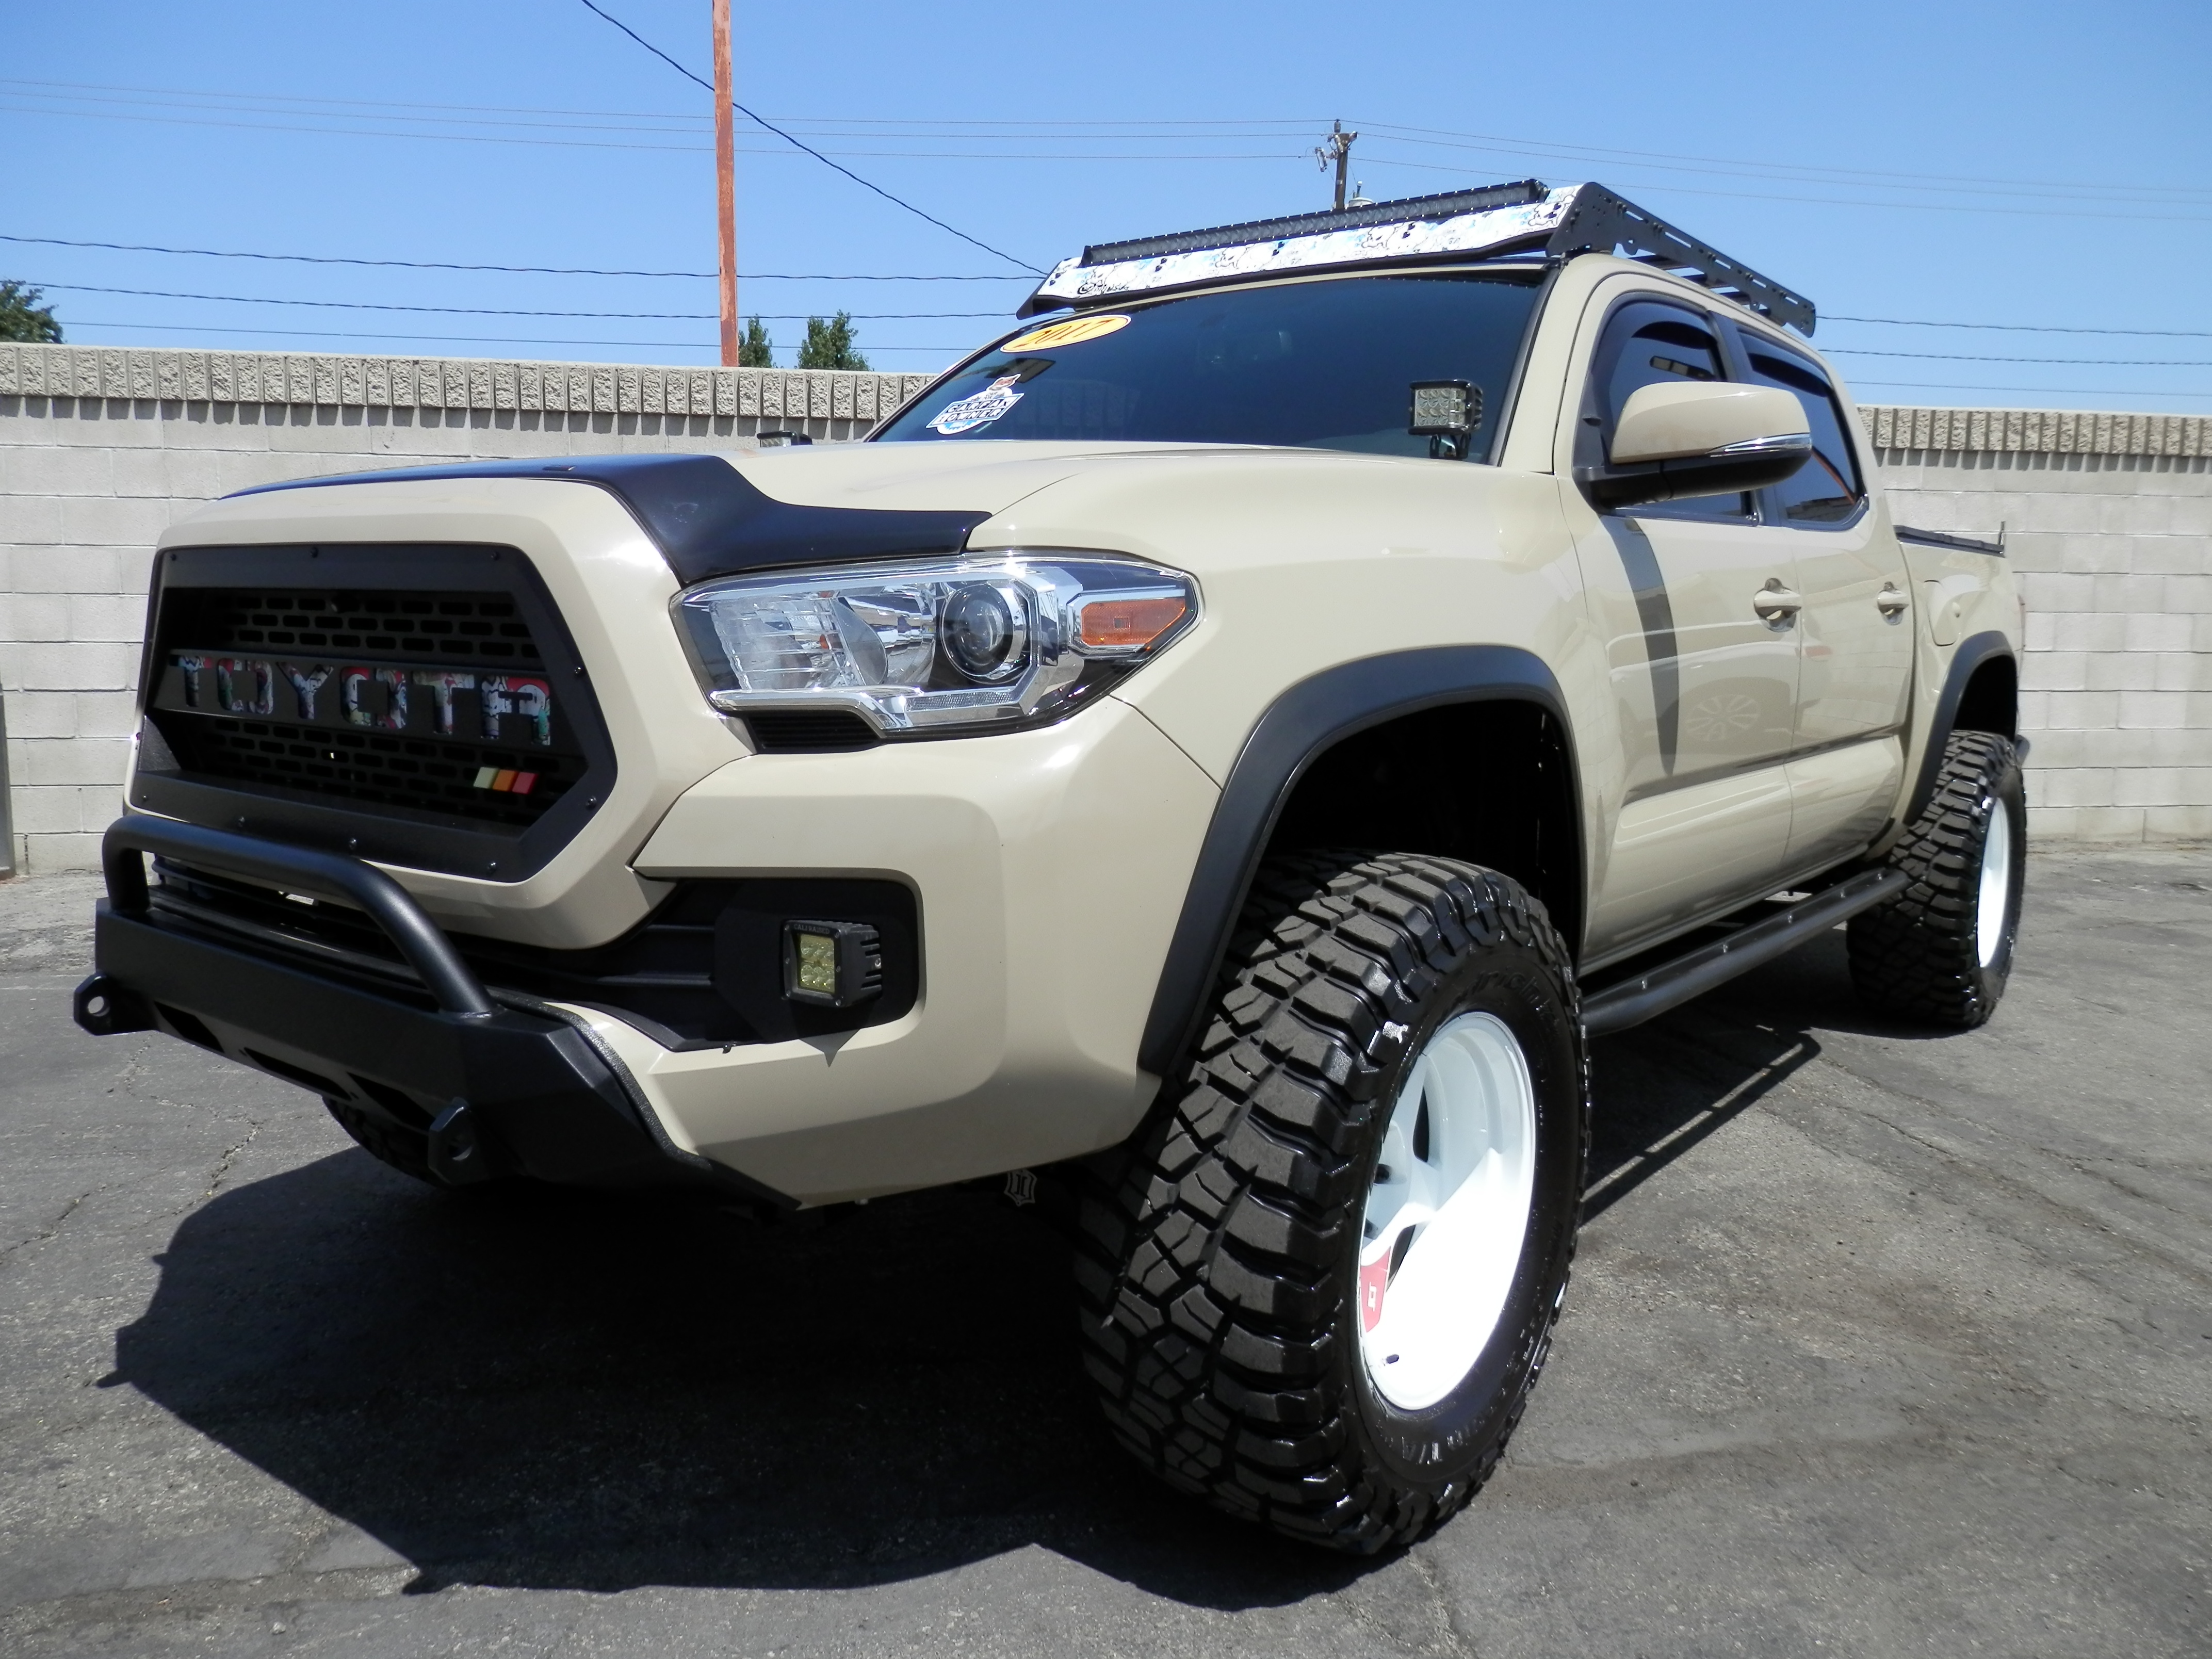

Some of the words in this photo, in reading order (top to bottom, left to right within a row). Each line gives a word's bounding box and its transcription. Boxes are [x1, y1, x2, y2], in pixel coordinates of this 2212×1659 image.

[1012, 318, 1116, 349] 2017
[947, 398, 1012, 413] CARFAX
[169, 655, 551, 746] TOYOTA
